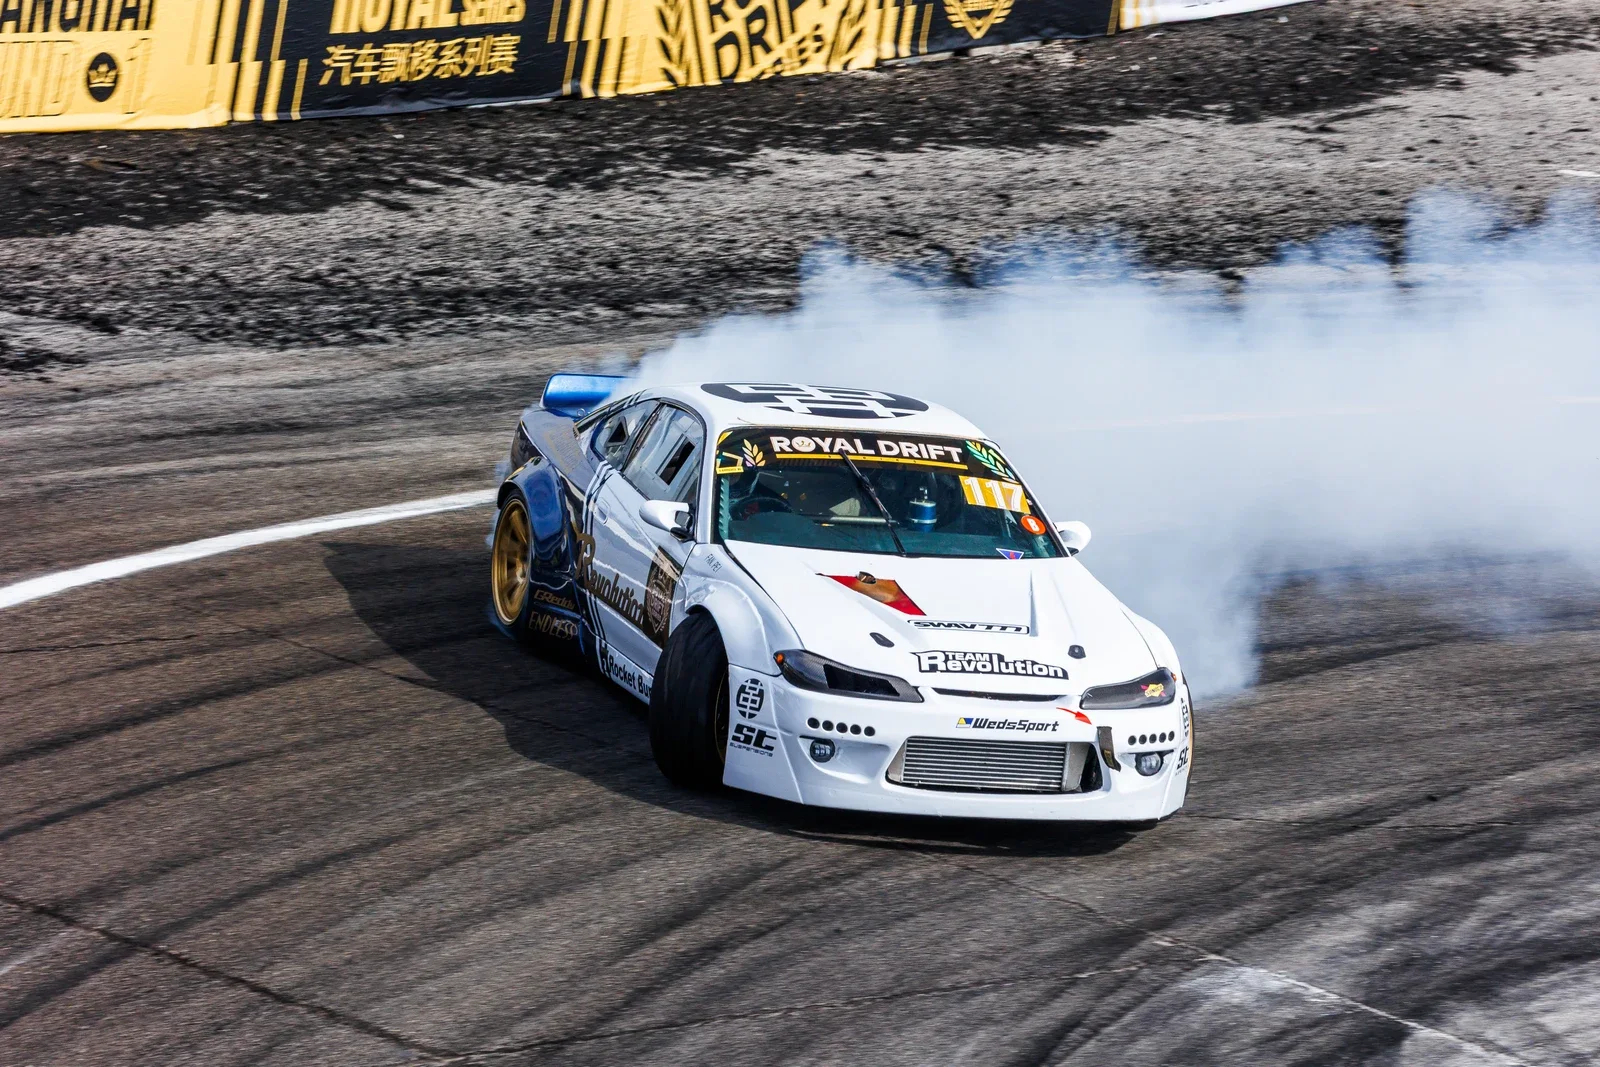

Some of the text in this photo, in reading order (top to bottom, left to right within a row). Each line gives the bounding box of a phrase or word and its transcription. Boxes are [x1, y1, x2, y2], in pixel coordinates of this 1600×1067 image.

[318, 34, 521, 86] 汽车飘移系列赛
[769, 436, 877, 456] ROYAL
[879, 440, 963, 463] DRIFT
[964, 477, 1022, 513] 117
[1026, 518, 1040, 532] B
[917, 651, 1065, 678] Revolution
[946, 652, 990, 662] TEAM
[608, 654, 637, 690] Rocket
[972, 718, 1059, 733] WedsSport
